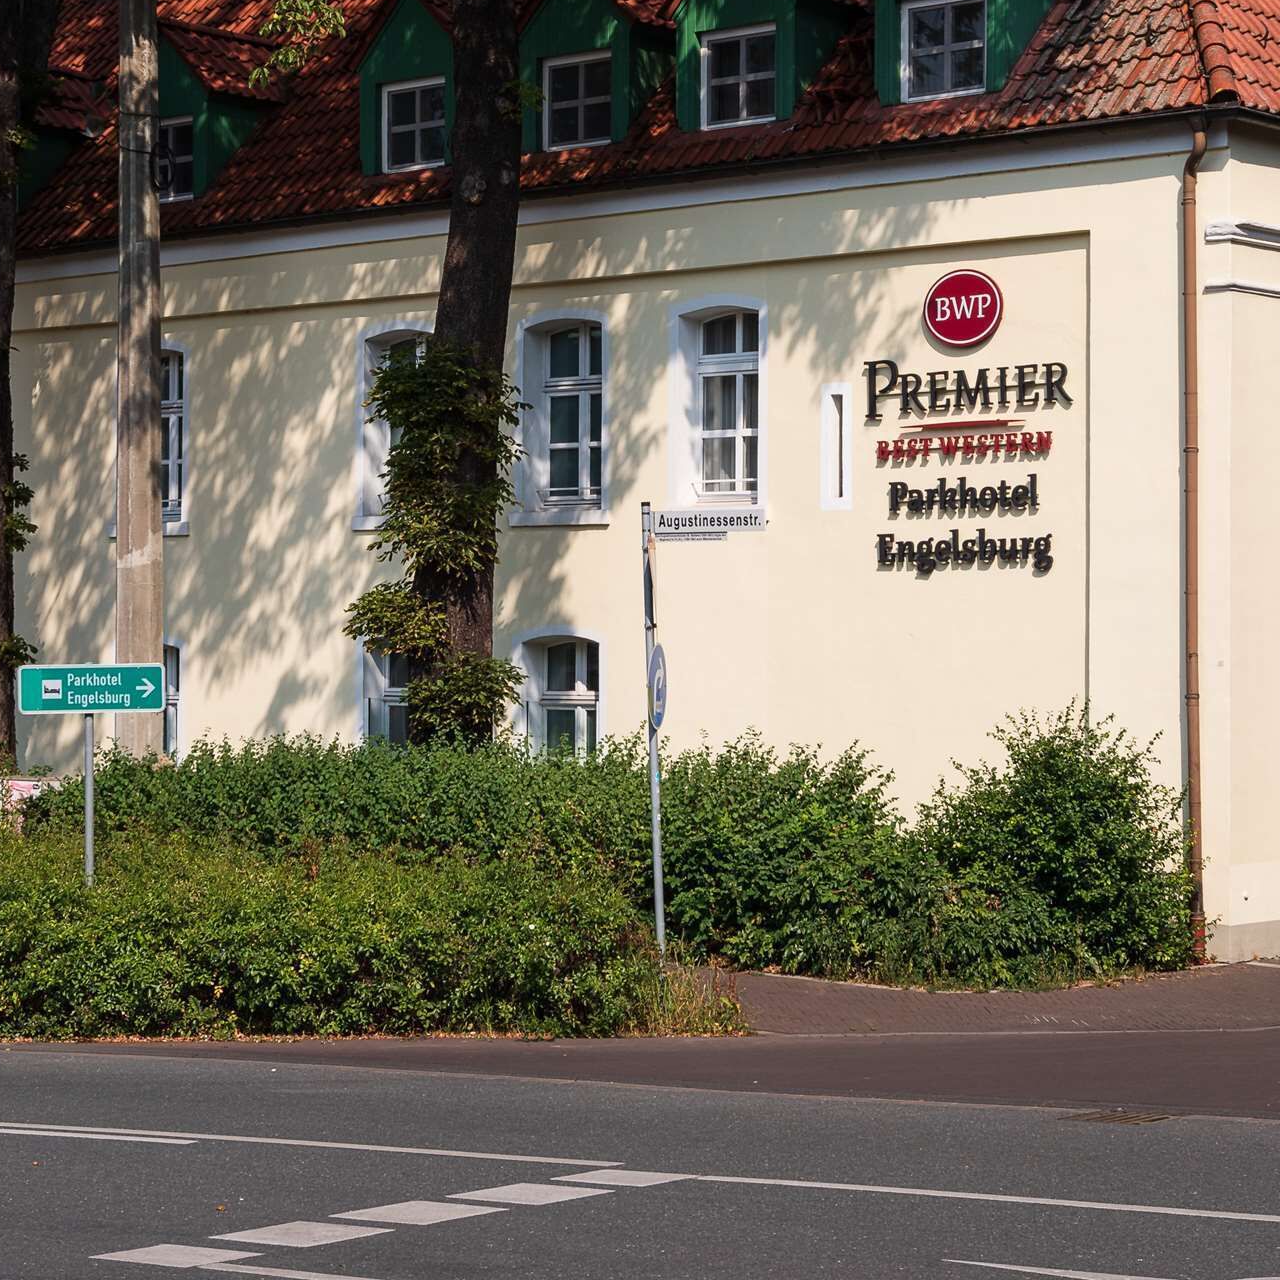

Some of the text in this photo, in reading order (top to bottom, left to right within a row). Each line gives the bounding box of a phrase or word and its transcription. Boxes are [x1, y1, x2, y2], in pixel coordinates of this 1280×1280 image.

[935, 293, 992, 322] BWP
[876, 430, 1053, 460] BEST WESTERN
[888, 473, 1040, 512] Parkhotel
[658, 513, 761, 530] Augustinessenstr.
[876, 528, 1054, 570] Engelsburg
[67, 673, 121, 686] Parkhotel
[67, 691, 131, 707] Engelsburg
